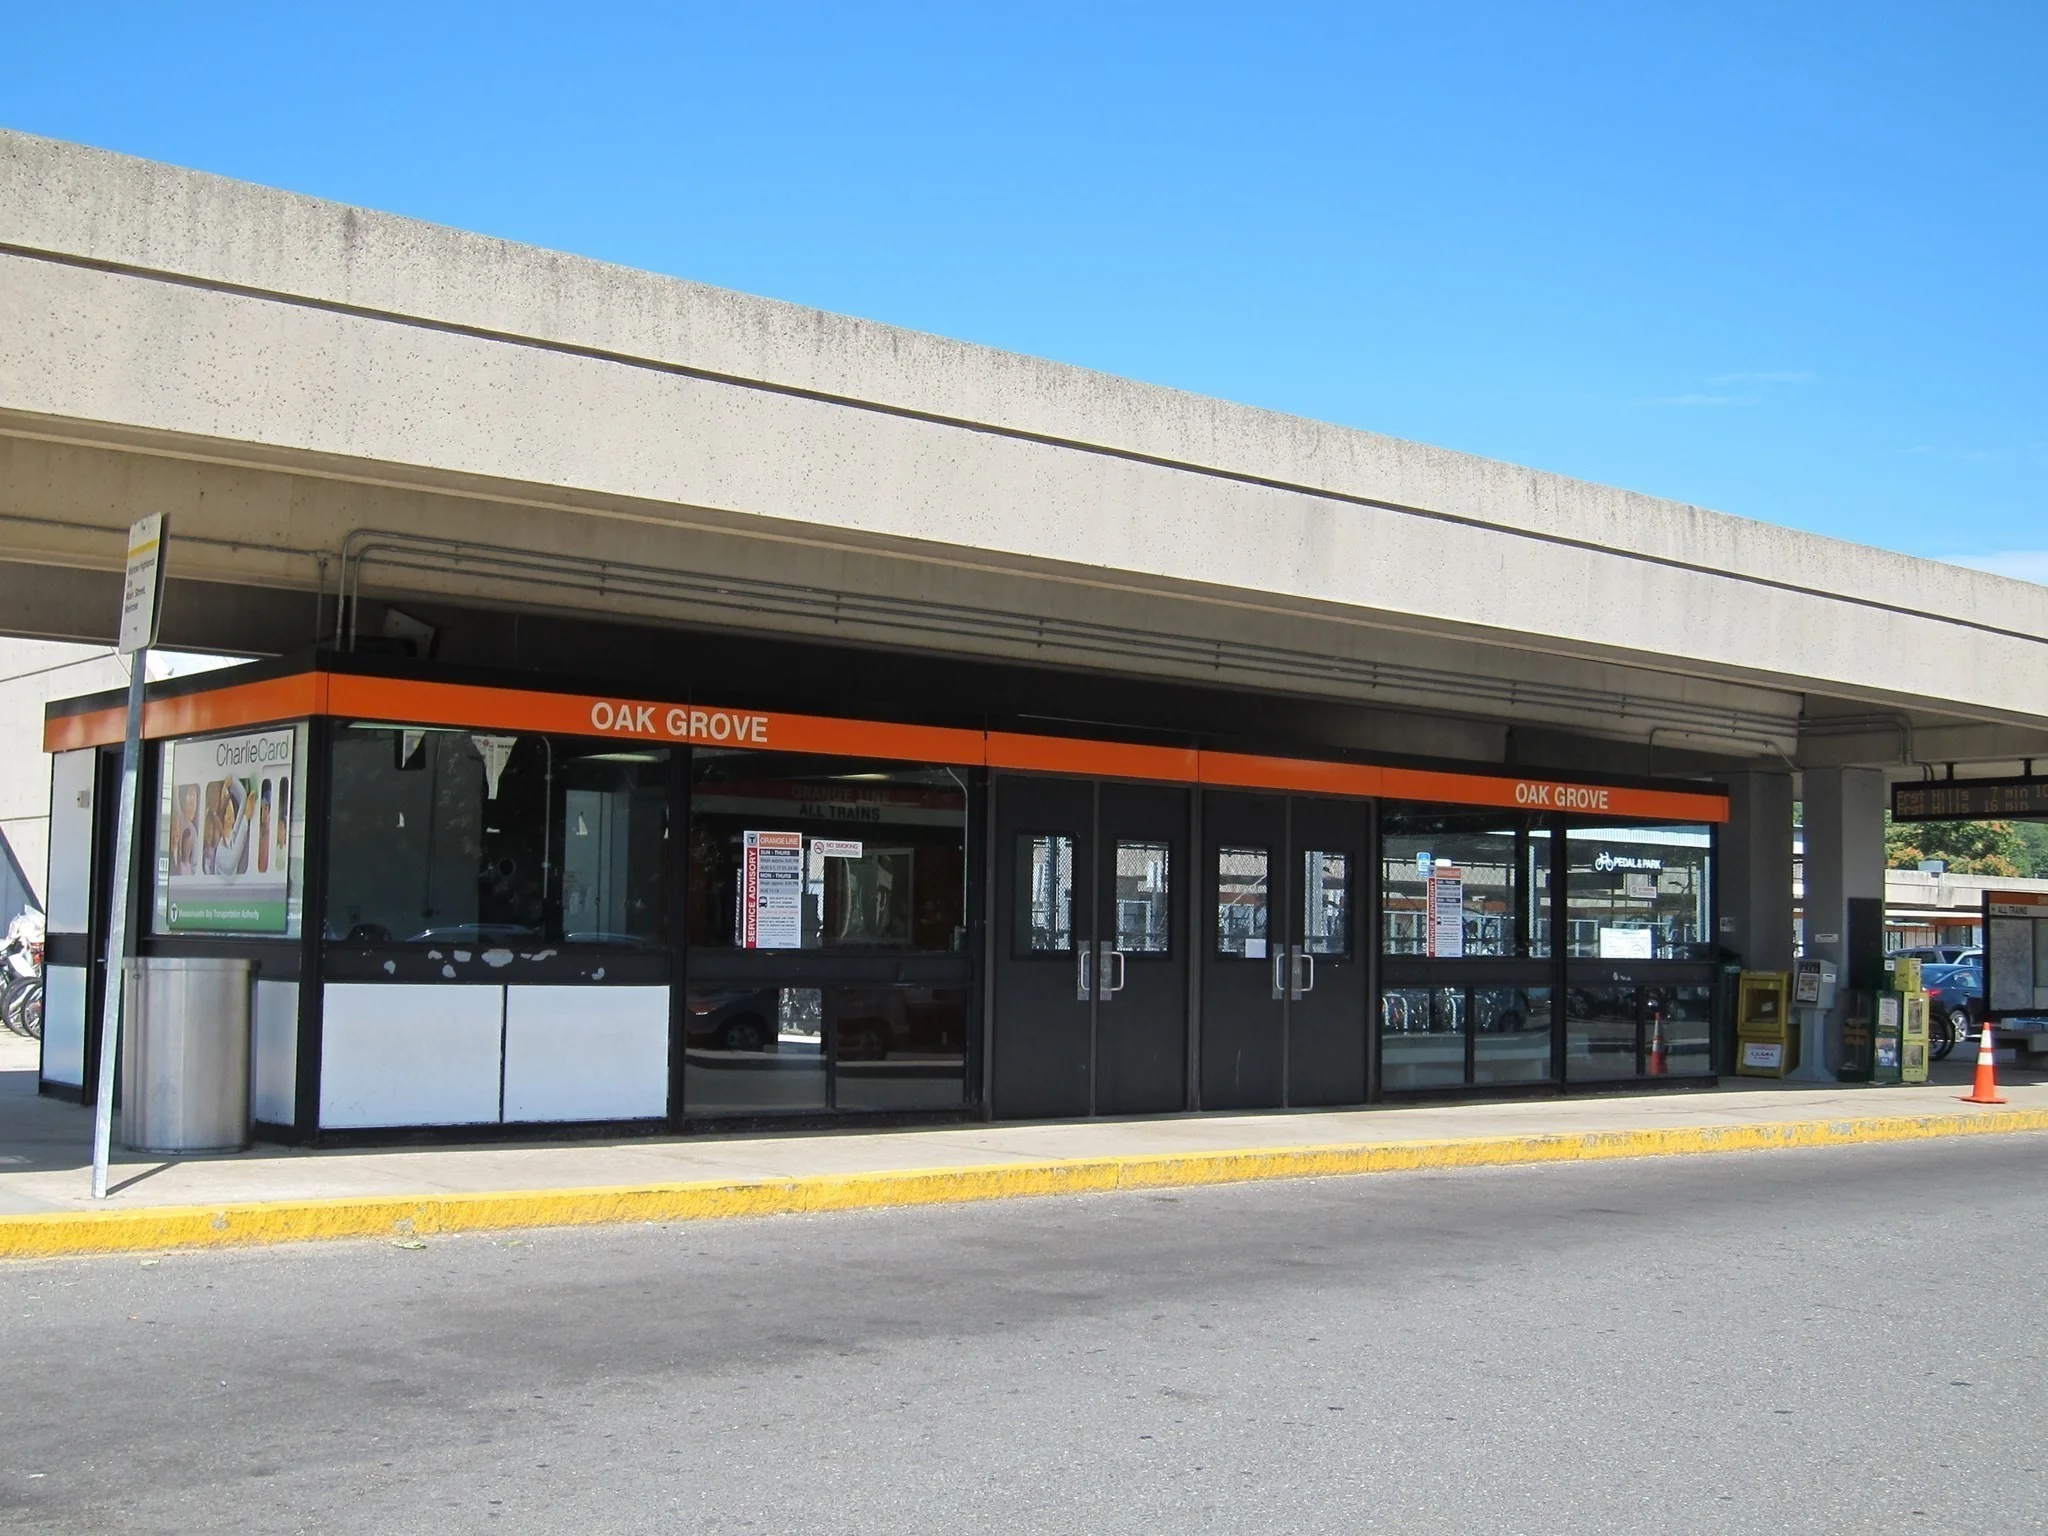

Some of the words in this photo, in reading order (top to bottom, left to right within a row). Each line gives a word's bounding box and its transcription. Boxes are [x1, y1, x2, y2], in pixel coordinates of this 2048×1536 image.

[591, 702, 656, 733] OAK
[666, 708, 768, 742] GROVE
[216, 736, 289, 767] CharlieCard
[1515, 783, 1550, 805] OAK
[1554, 786, 1609, 809] GROVE
[1896, 790, 1924, 803] Frst
[1932, 788, 1969, 802] Hills
[1990, 787, 1998, 800] 7
[2004, 785, 2028, 799] min
[799, 804, 824, 818] ALL
[829, 805, 881, 821] TRAINS
[1896, 803, 1924, 816] Frst
[1932, 801, 1969, 815] Hills
[1984, 800, 1998, 813] 16
[2004, 799, 2029, 812] min
[760, 837, 785, 845] ORANGE
[1613, 857, 1636, 868] PEDAL
[1643, 859, 1661, 869] PARK
[748, 851, 757, 900] ADVISORY
[1997, 905, 2008, 914] ALL
[748, 901, 757, 942] SERVICE
